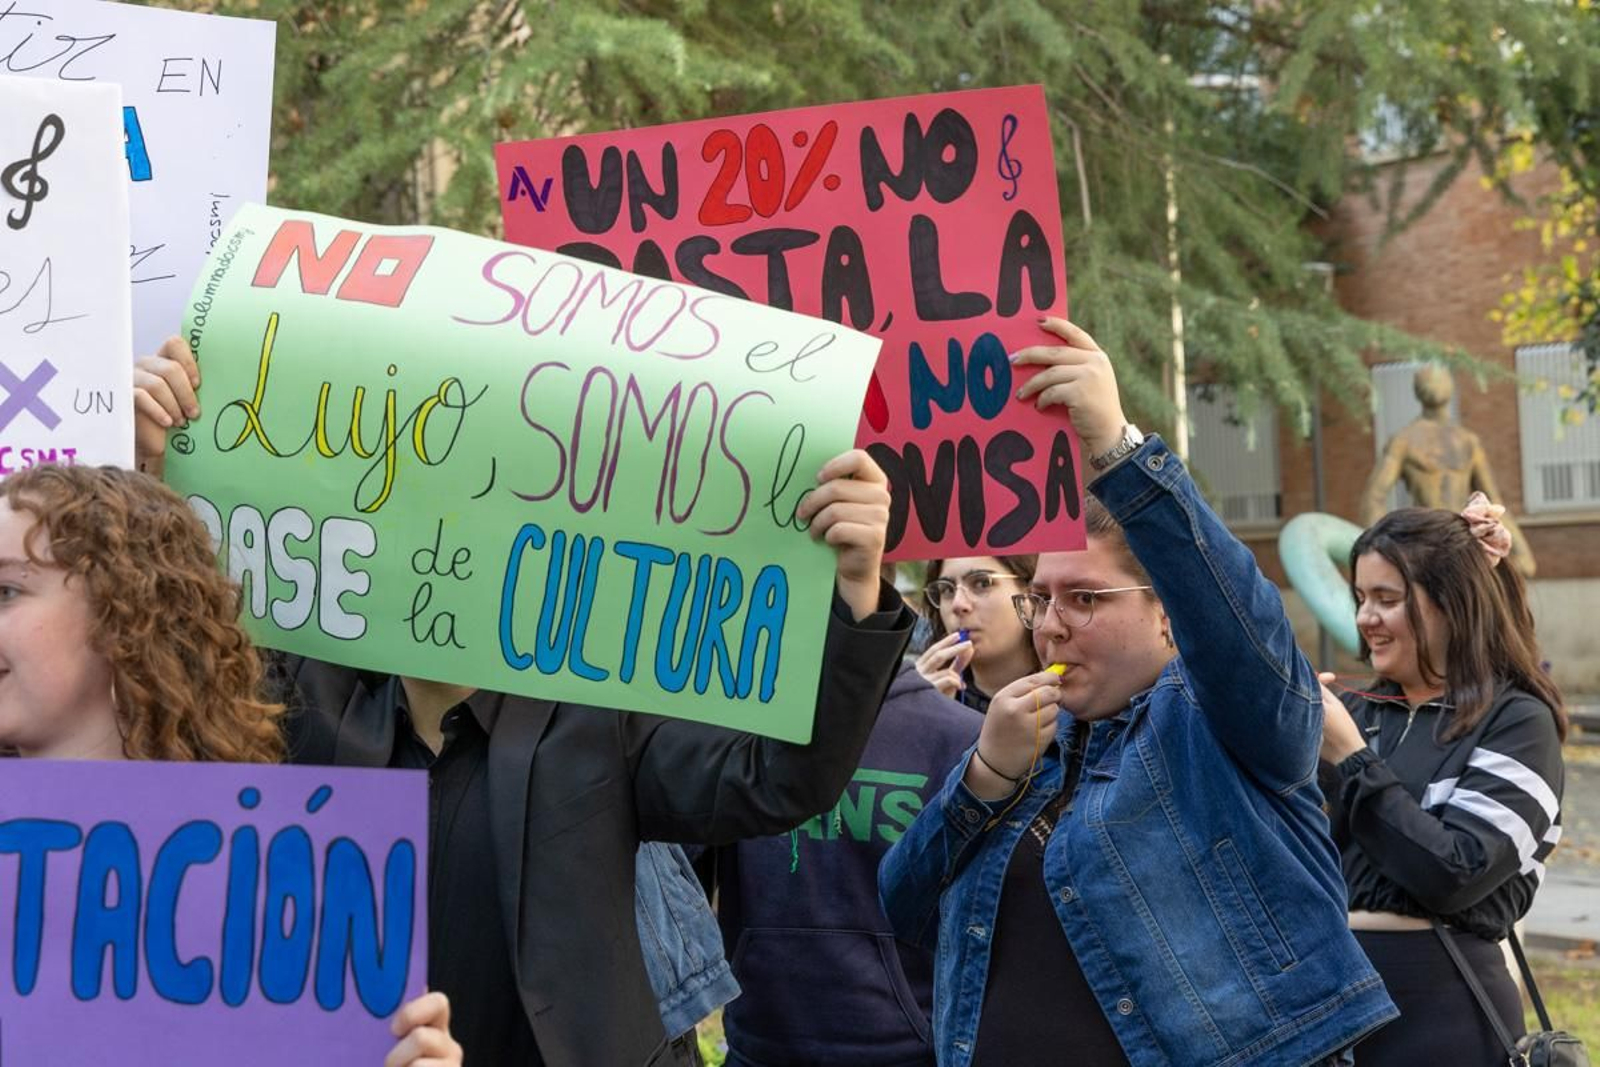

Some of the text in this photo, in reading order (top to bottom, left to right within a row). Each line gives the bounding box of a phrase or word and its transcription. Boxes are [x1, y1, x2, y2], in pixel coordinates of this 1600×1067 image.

[156, 57, 222, 96] EN
[561, 142, 679, 235] UN
[698, 120, 840, 226] 20%
[860, 108, 978, 212] NO
[251, 219, 435, 308] NO
[451, 250, 720, 360] SOMOS
[745, 332, 837, 383] el
[908, 209, 1056, 321] LA
[74, 388, 113, 414] UN
[909, 332, 1013, 430] NO
[507, 361, 775, 536] SOMOS
[411, 517, 473, 581] de
[403, 582, 467, 649] la
[499, 523, 789, 704] CULTURA
